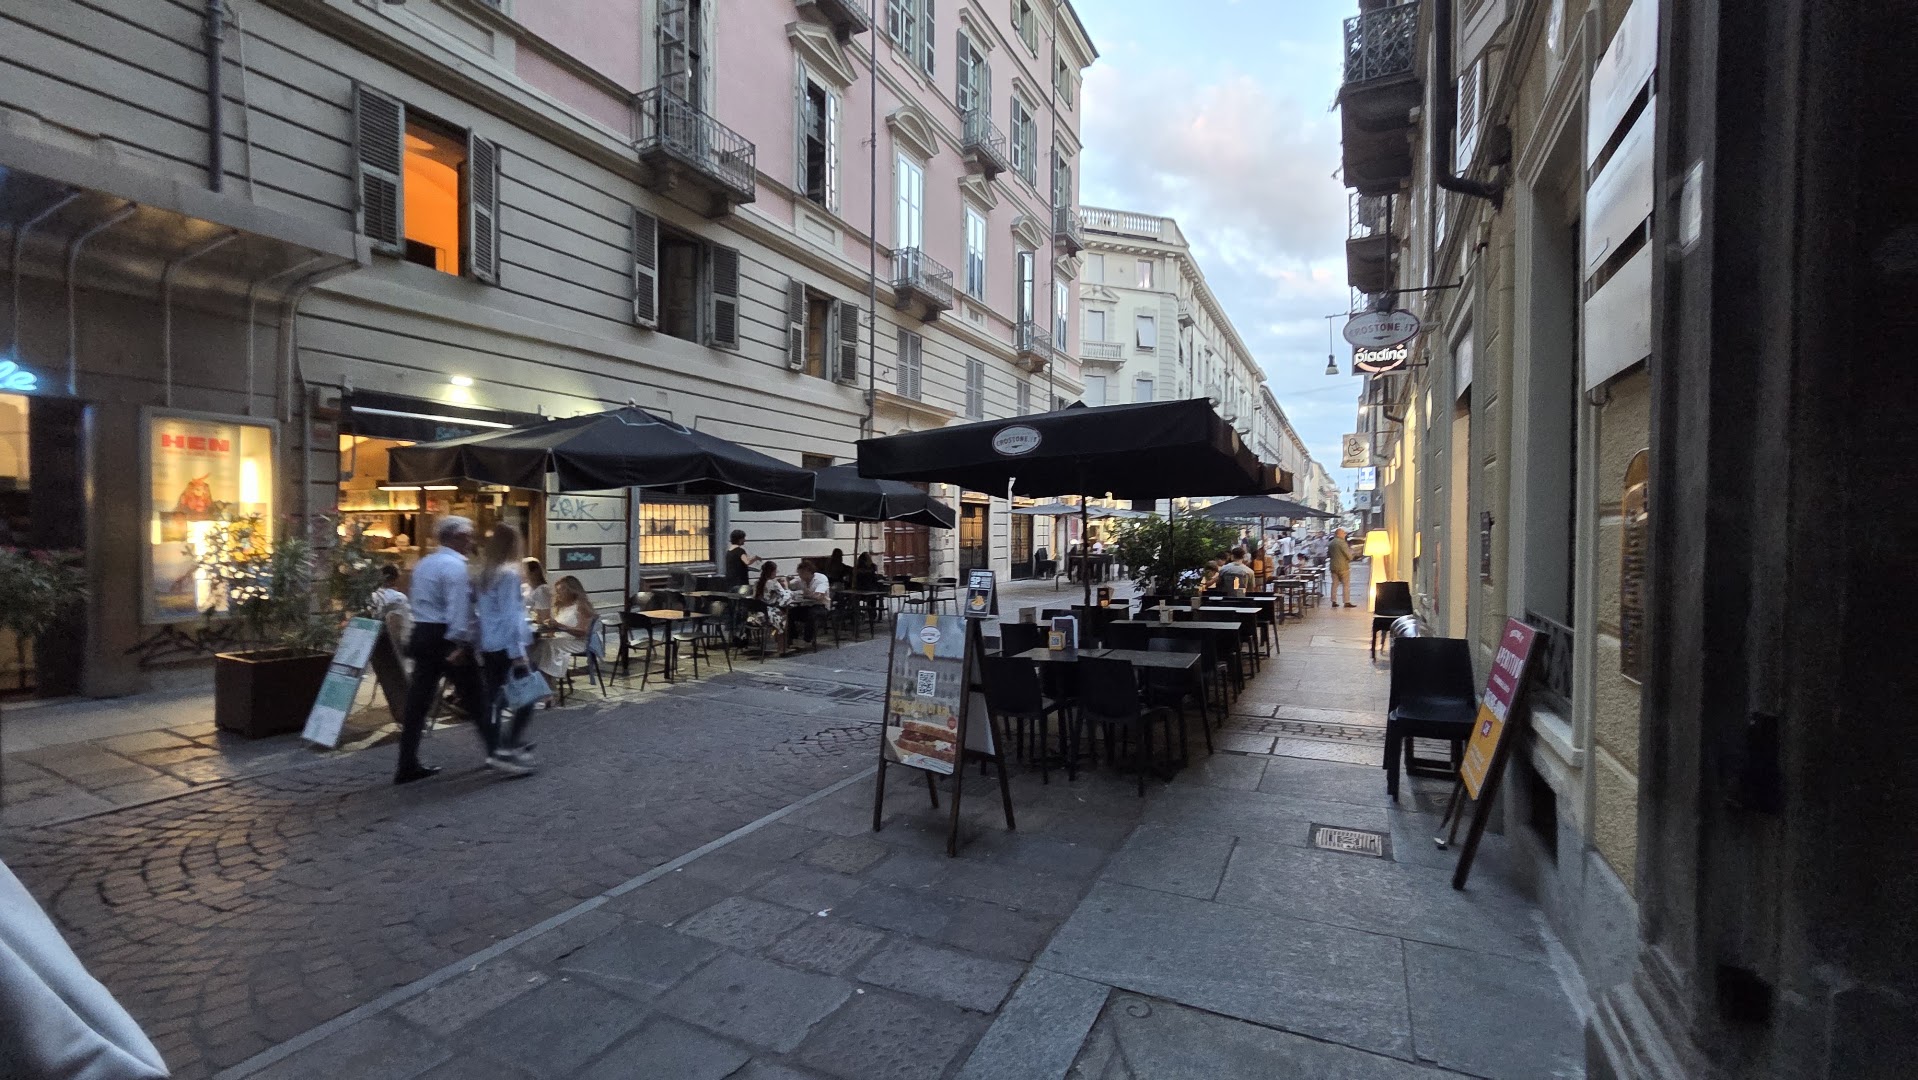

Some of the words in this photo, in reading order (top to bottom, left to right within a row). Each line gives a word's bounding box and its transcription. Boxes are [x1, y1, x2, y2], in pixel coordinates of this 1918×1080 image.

[1348, 323, 1415, 337] CROSTONE.IT
[1354, 348, 1407, 365] piadina
[161, 434, 230, 452] HEN
